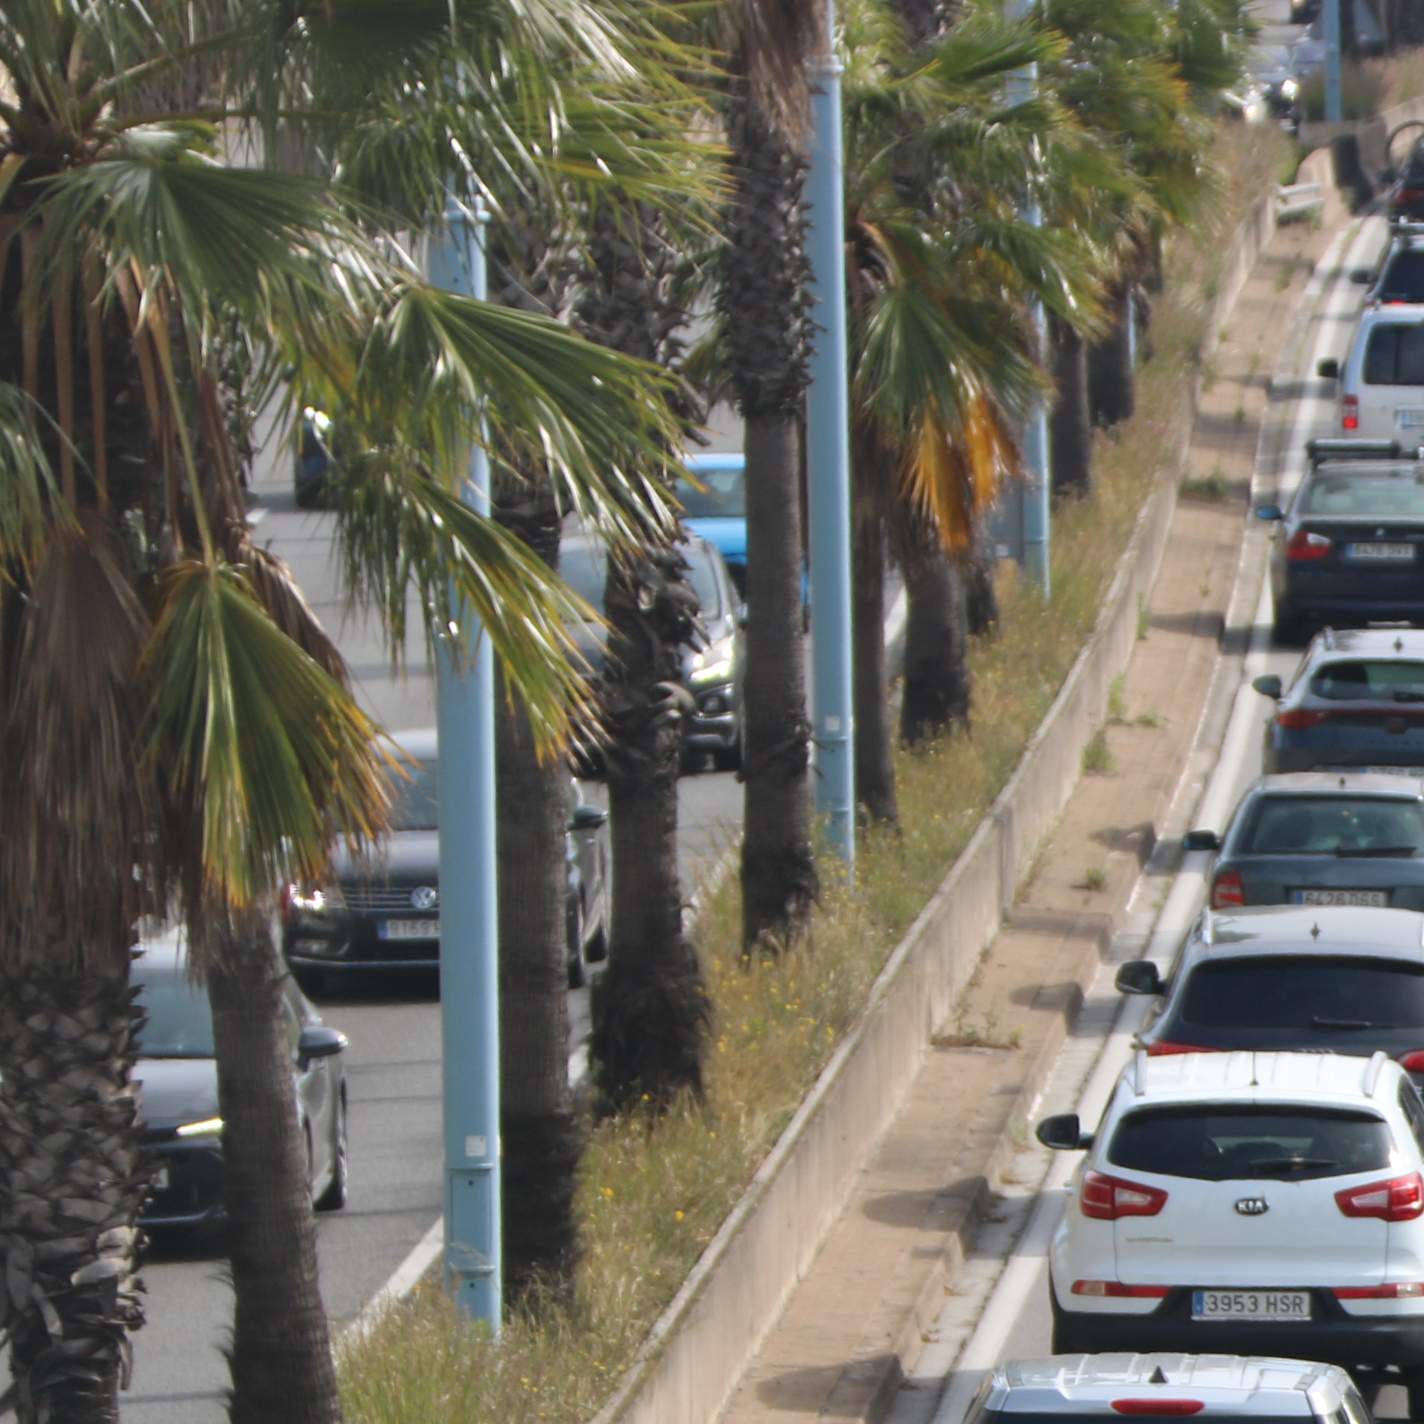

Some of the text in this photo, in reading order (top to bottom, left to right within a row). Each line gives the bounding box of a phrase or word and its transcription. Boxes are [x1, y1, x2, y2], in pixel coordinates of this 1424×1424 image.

[1237, 1200, 1265, 1212] KIA
[1206, 1294, 1305, 1314] 3953 HSR
